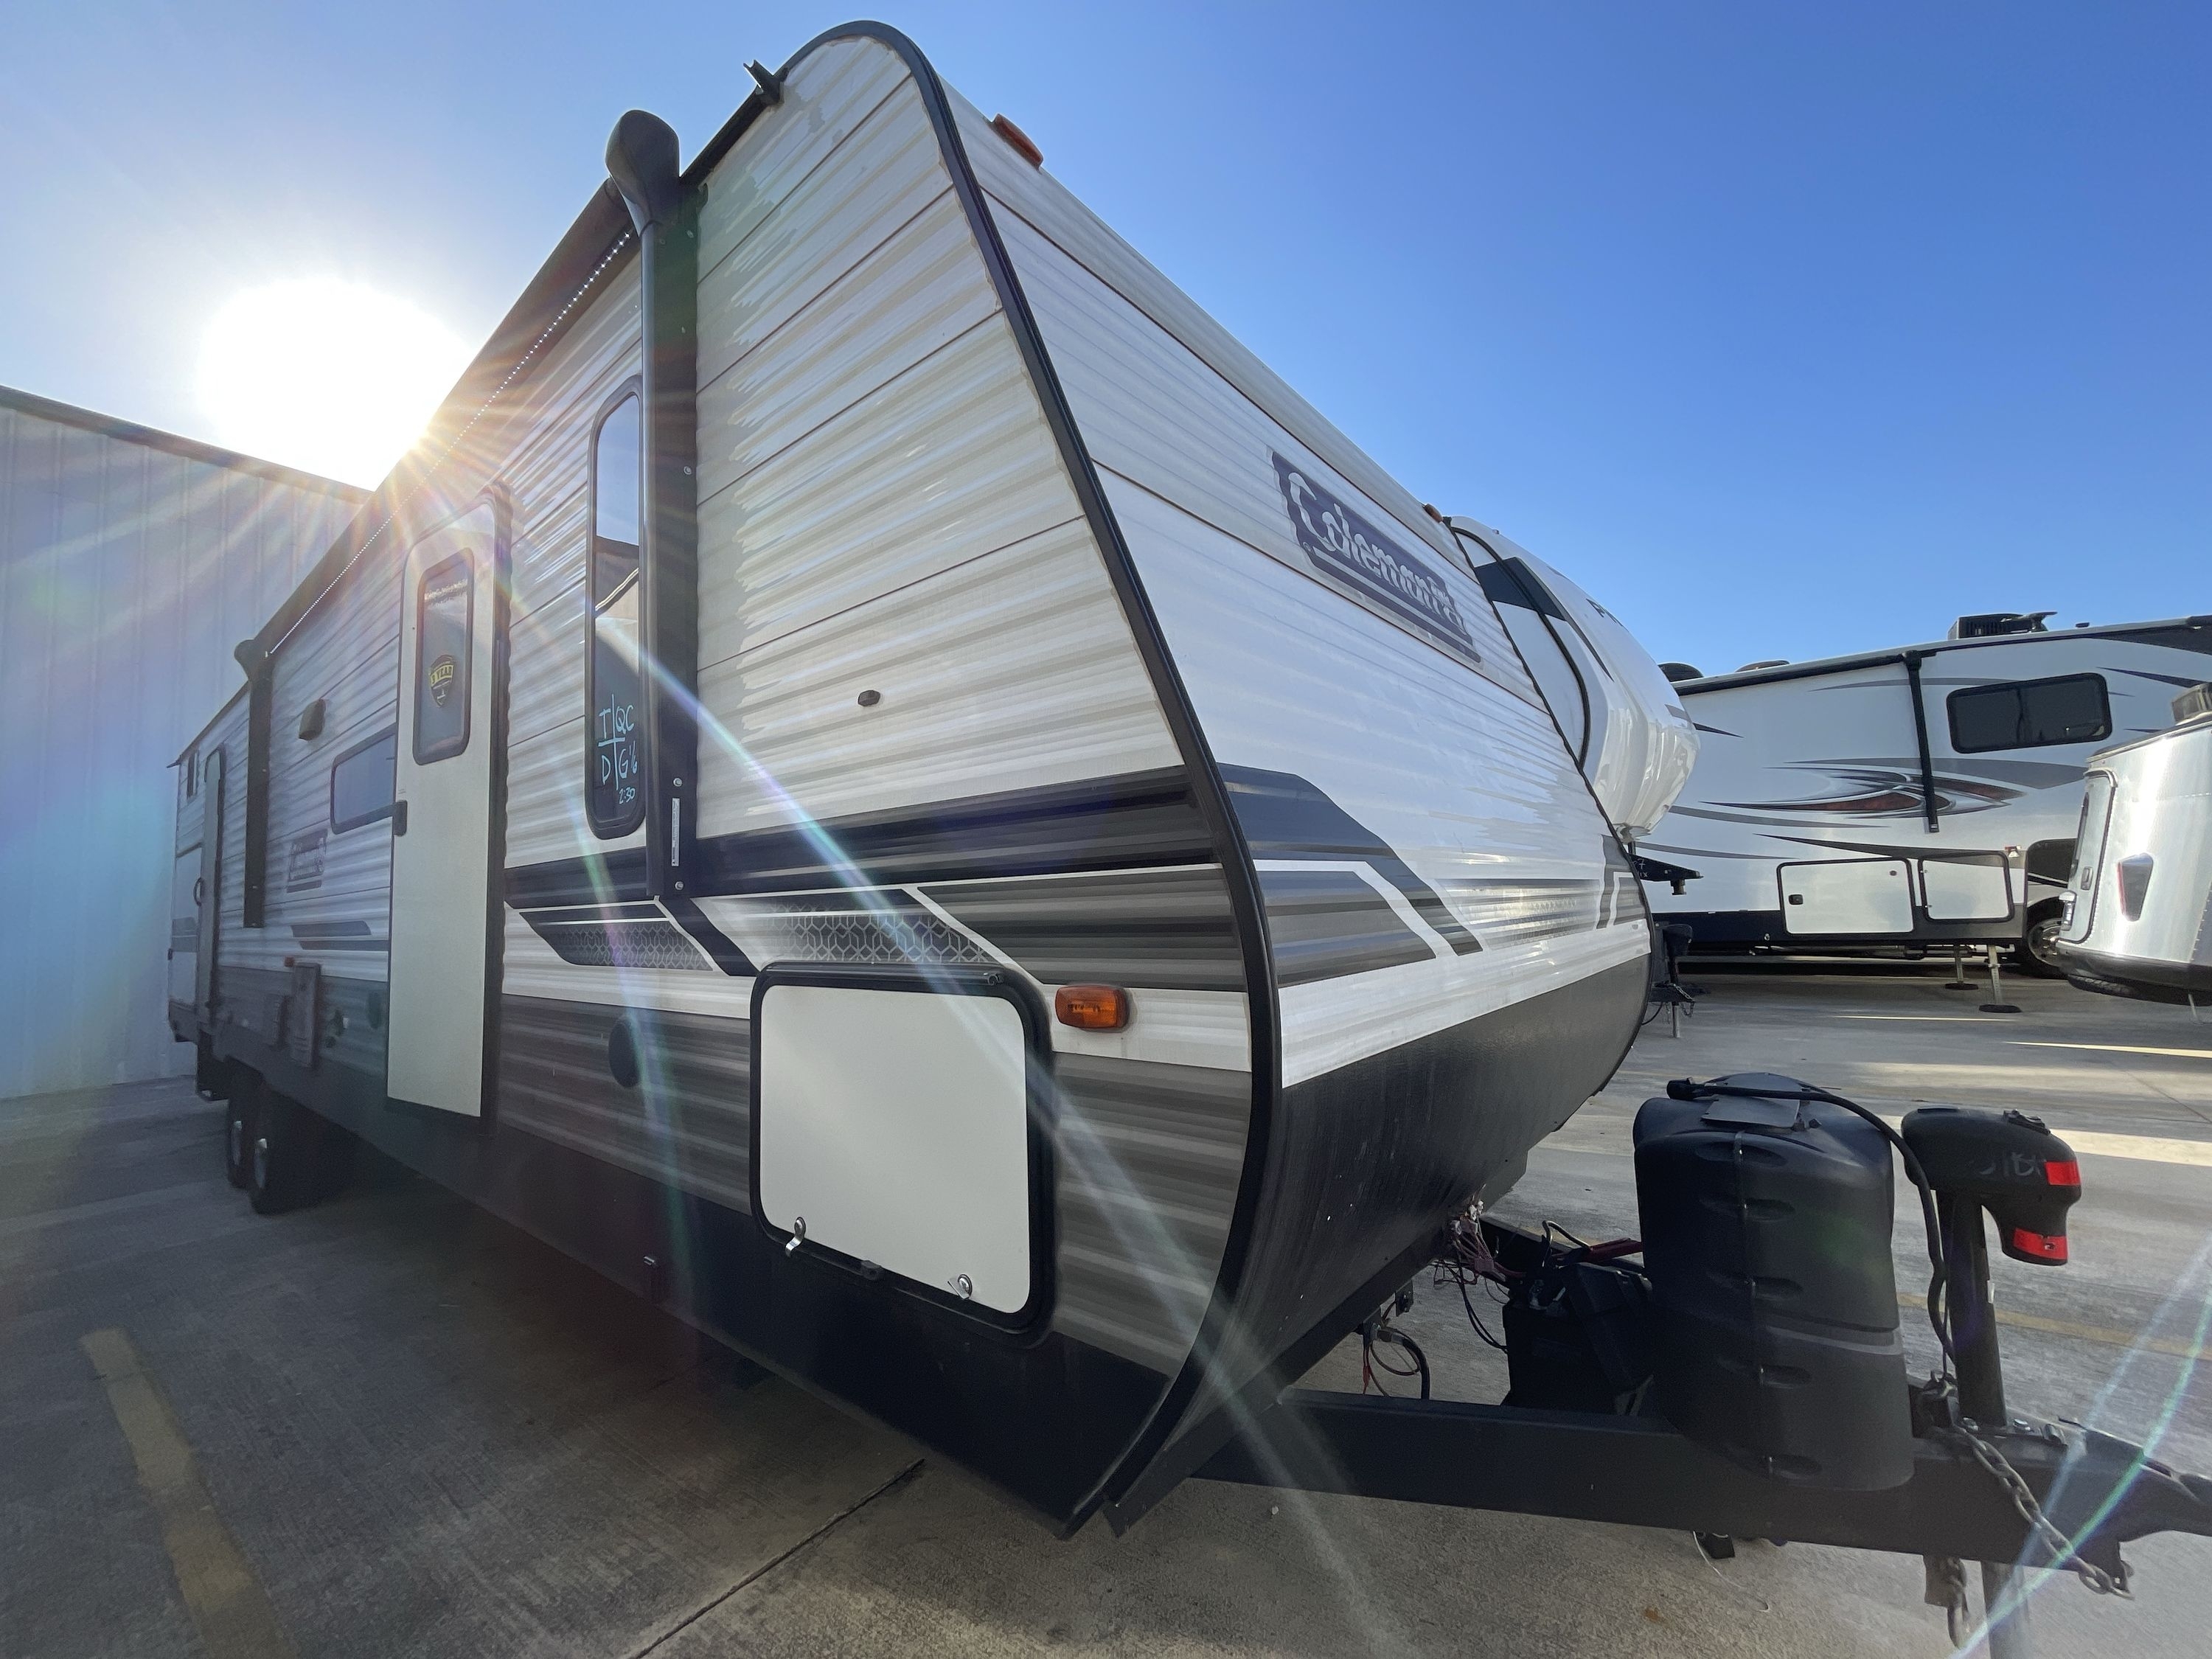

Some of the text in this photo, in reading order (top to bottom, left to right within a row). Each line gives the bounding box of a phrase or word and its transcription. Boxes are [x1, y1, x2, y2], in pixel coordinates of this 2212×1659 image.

[1288, 471, 1447, 621] Coleman
[616, 705, 635, 734] QC
[601, 755, 611, 785] D
[619, 786, 636, 804] 2:30
